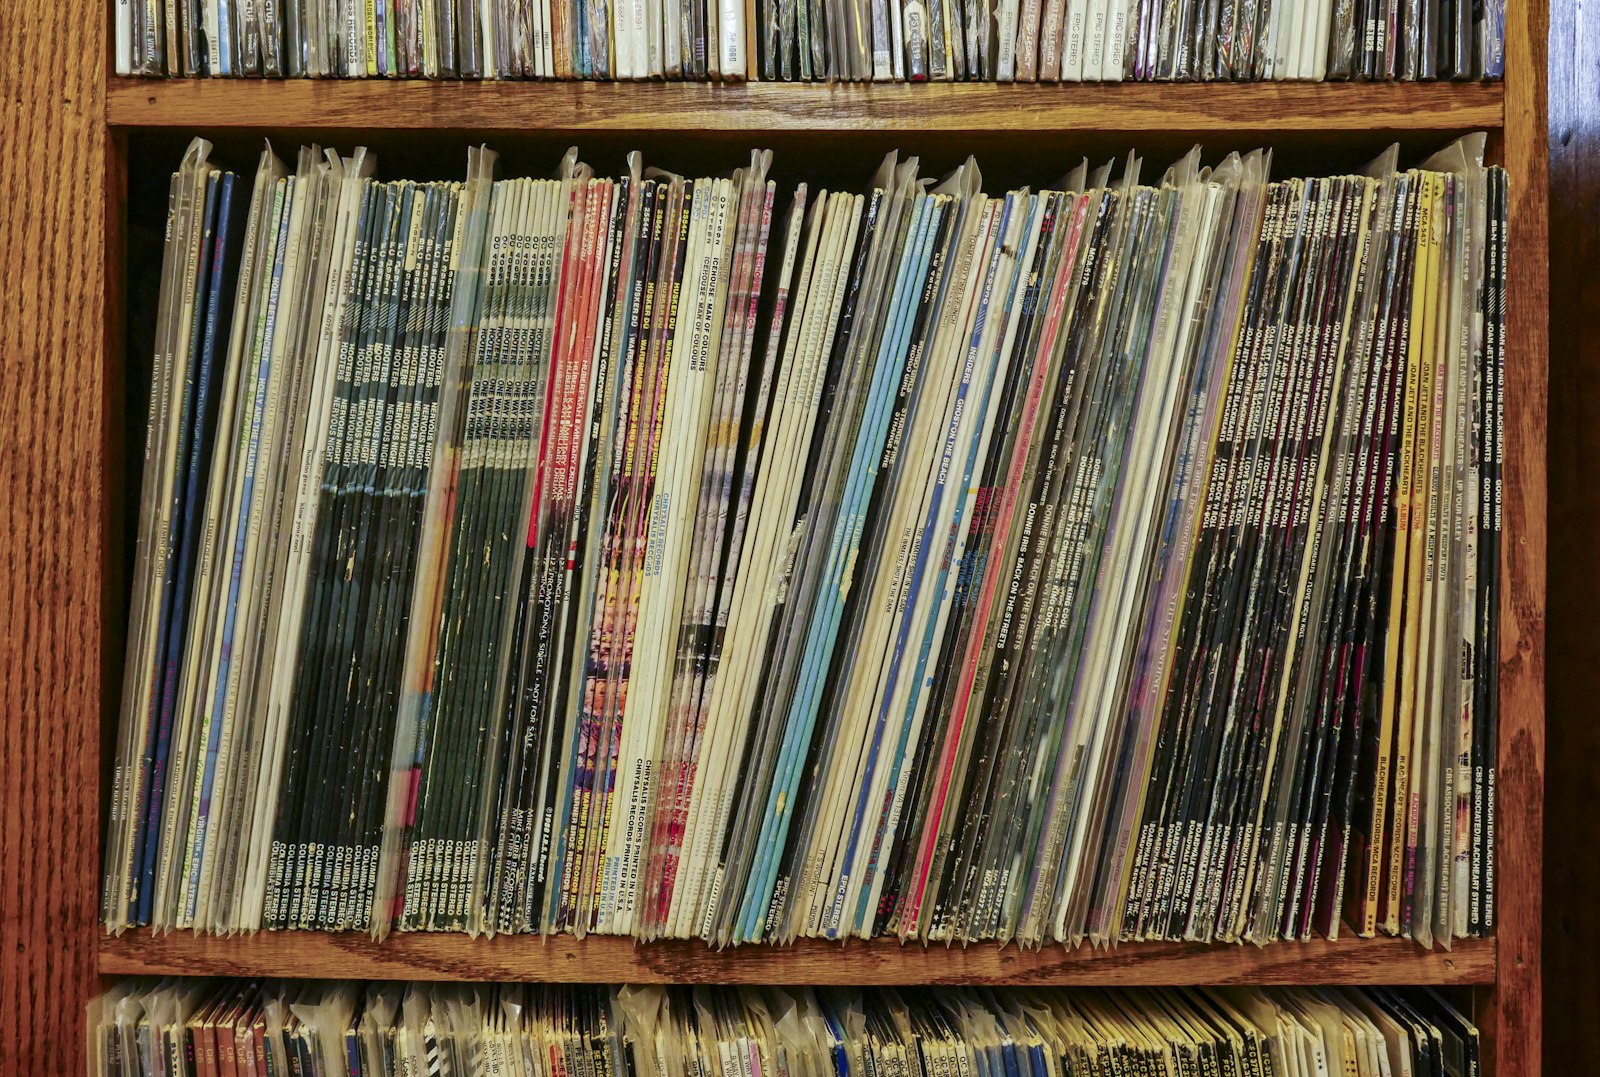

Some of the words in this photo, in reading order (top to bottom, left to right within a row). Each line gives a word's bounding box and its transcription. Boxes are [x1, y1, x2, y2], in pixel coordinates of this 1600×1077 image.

[1095, 12, 1104, 31] EPIC
[1116, 12, 1124, 31] EPIC
[1092, 33, 1101, 65] STEREO
[1112, 33, 1122, 65] STEREO
[654, 209, 663, 240] 25544-1
[1420, 208, 1428, 247] MCA-5437
[707, 257, 719, 297] ICEHOUSE
[1081, 248, 1096, 286] MCA-5179
[269, 277, 280, 302] HOLLY
[644, 282, 655, 317] HÜSKER
[1018, 270, 1032, 305] Interview
[266, 304, 276, 326] BETH
[642, 318, 650, 329] DÜ
[705, 303, 713, 321] MAN
[601, 317, 612, 350] HUNTERS
[703, 323, 711, 333] OF
[1486, 321, 1494, 343] JOAN
[261, 327, 273, 362] VINCENT
[477, 328, 488, 365] HOOTERS
[699, 335, 710, 372] COLOURS
[1486, 345, 1494, 365] JETT
[337, 342, 348, 380] HOOTERS
[408, 348, 419, 386] HOOTERS
[906, 344, 917, 372] INDIGO
[963, 346, 977, 384] INSIDERS
[900, 373, 911, 397] GIRLS
[1409, 363, 1417, 384] JOAN
[1485, 367, 1493, 383] AND
[256, 378, 266, 404] HOLLY
[472, 381, 480, 397] ONE
[1485, 385, 1493, 401] THE
[253, 406, 262, 422] AND
[470, 399, 478, 415] WAY
[630, 394, 641, 421] SONGS
[1406, 406, 1414, 422] AND
[251, 424, 260, 440] THE
[426, 402, 437, 440] NERVOUS
[466, 417, 476, 441] HOME
[628, 423, 638, 440] AND
[886, 411, 901, 449] STRANGE
[948, 428, 958, 439] ON
[1405, 424, 1413, 439] THE
[1484, 403, 1493, 462] BLACKHEARTS
[246, 441, 258, 477] ITALIANS
[423, 442, 433, 467] NIGHT
[624, 443, 635, 477] STORIES
[882, 450, 892, 468] FIRE
[944, 440, 955, 456] THE
[1197, 441, 1208, 463] Jason
[937, 457, 951, 484] BEACH
[1089, 458, 1102, 488] DONNIE
[1386, 457, 1394, 473] LOVE
[1401, 441, 1412, 495] BLACKHEARTS
[1192, 470, 1202, 487] and
[1383, 476, 1392, 495] ROCK
[1456, 480, 1464, 491] UP
[1483, 478, 1491, 501] GOOD
[1085, 490, 1095, 505] IRIS
[1188, 492, 1198, 510] The
[1022, 503, 1037, 534] DONNIE
[1082, 507, 1092, 523] AND
[1380, 506, 1389, 523] ROLL
[1398, 503, 1407, 531] ALBUM
[903, 528, 911, 537] THE
[1078, 525, 1088, 540] THE
[1178, 514, 1194, 561] Scorchers
[1454, 516, 1462, 541] ALLEY
[1018, 536, 1030, 552] IRIS
[1012, 557, 1025, 580] BACK
[1070, 542, 1085, 581] CRUISERS
[889, 588, 898, 598] THE
[1009, 581, 1020, 594] ON
[1064, 586, 1076, 606] KING
[539, 573, 554, 640] PROMOTIONAL
[885, 600, 895, 614] DARK
[1005, 596, 1016, 611] THE
[997, 613, 1012, 648] STREETS
[1060, 608, 1071, 629] COOL
[535, 643, 546, 674] SINGLE
[1152, 626, 1172, 693] STANDING
[532, 684, 540, 703] NOT
[530, 706, 538, 723] FOR
[526, 726, 535, 748] SALE
[630, 759, 642, 802] CHRYSALIS
[898, 770, 911, 791] Virgin
[1376, 756, 1386, 807] BLACKHEART
[1475, 766, 1483, 782] CBS
[580, 792, 591, 826] WARNER
[896, 792, 906, 804] VA
[515, 810, 524, 832] MIKE
[625, 805, 637, 841] RECORDS
[512, 834, 522, 859] CURB
[576, 828, 586, 852] BROS.
[1188, 823, 1203, 865] BOARDWALK
[1371, 808, 1382, 864] RECORDS/MCA
[1472, 784, 1482, 890] ASSOCIATED/BLACKHEART
[359, 849, 370, 891] COLUMBIA
[451, 840, 463, 881] COLUMBIA
[571, 854, 583, 892] RECORDS
[621, 844, 632, 877] PRINTED
[506, 861, 519, 904] RECORDS
[619, 879, 627, 888] IN
[837, 875, 848, 894] EPIC
[977, 870, 992, 908] MCA-5237
[1182, 867, 1195, 900] RECORDS,
[1368, 866, 1378, 902] RECORDS
[185, 884, 198, 917] STEREO
[355, 893, 365, 925] STEREO
[447, 883, 458, 915] STEREO
[569, 895, 578, 911] INC.
[616, 890, 626, 913] U.S.A.
[831, 895, 844, 926] STEREO
[1179, 902, 1189, 915] INC.
[1471, 892, 1480, 924] STEREO
